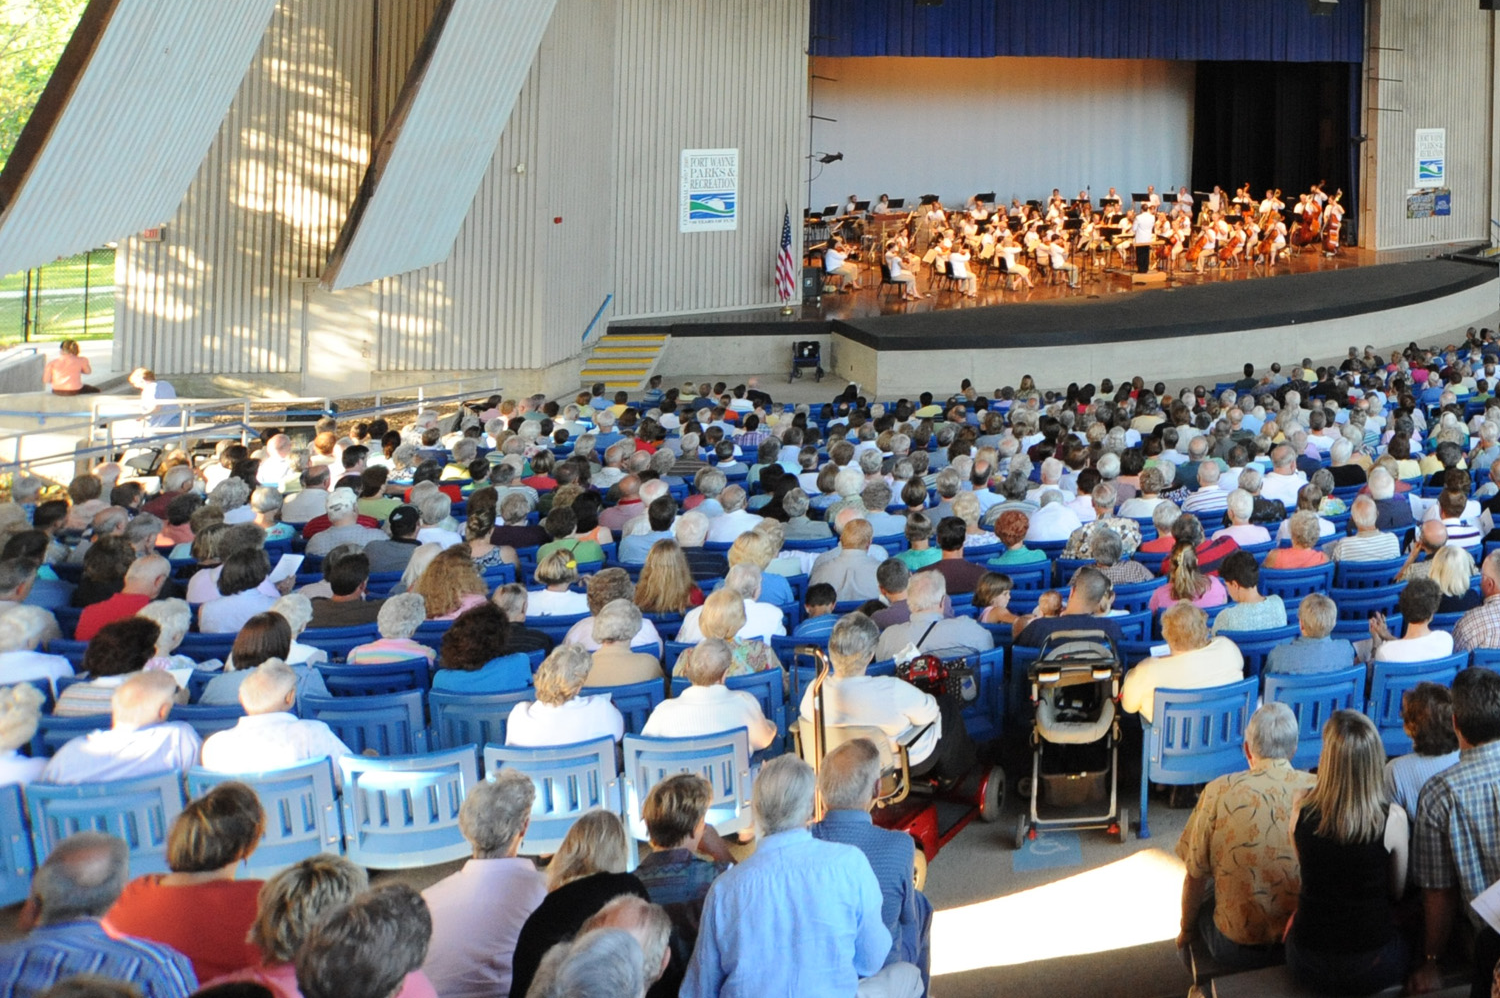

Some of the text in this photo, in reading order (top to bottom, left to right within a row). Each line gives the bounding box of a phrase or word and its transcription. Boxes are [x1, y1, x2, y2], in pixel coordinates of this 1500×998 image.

[690, 156, 735, 167] FORT WAYNE
[690, 167, 735, 178] PARKS &
[690, 178, 735, 189] RECREATION
